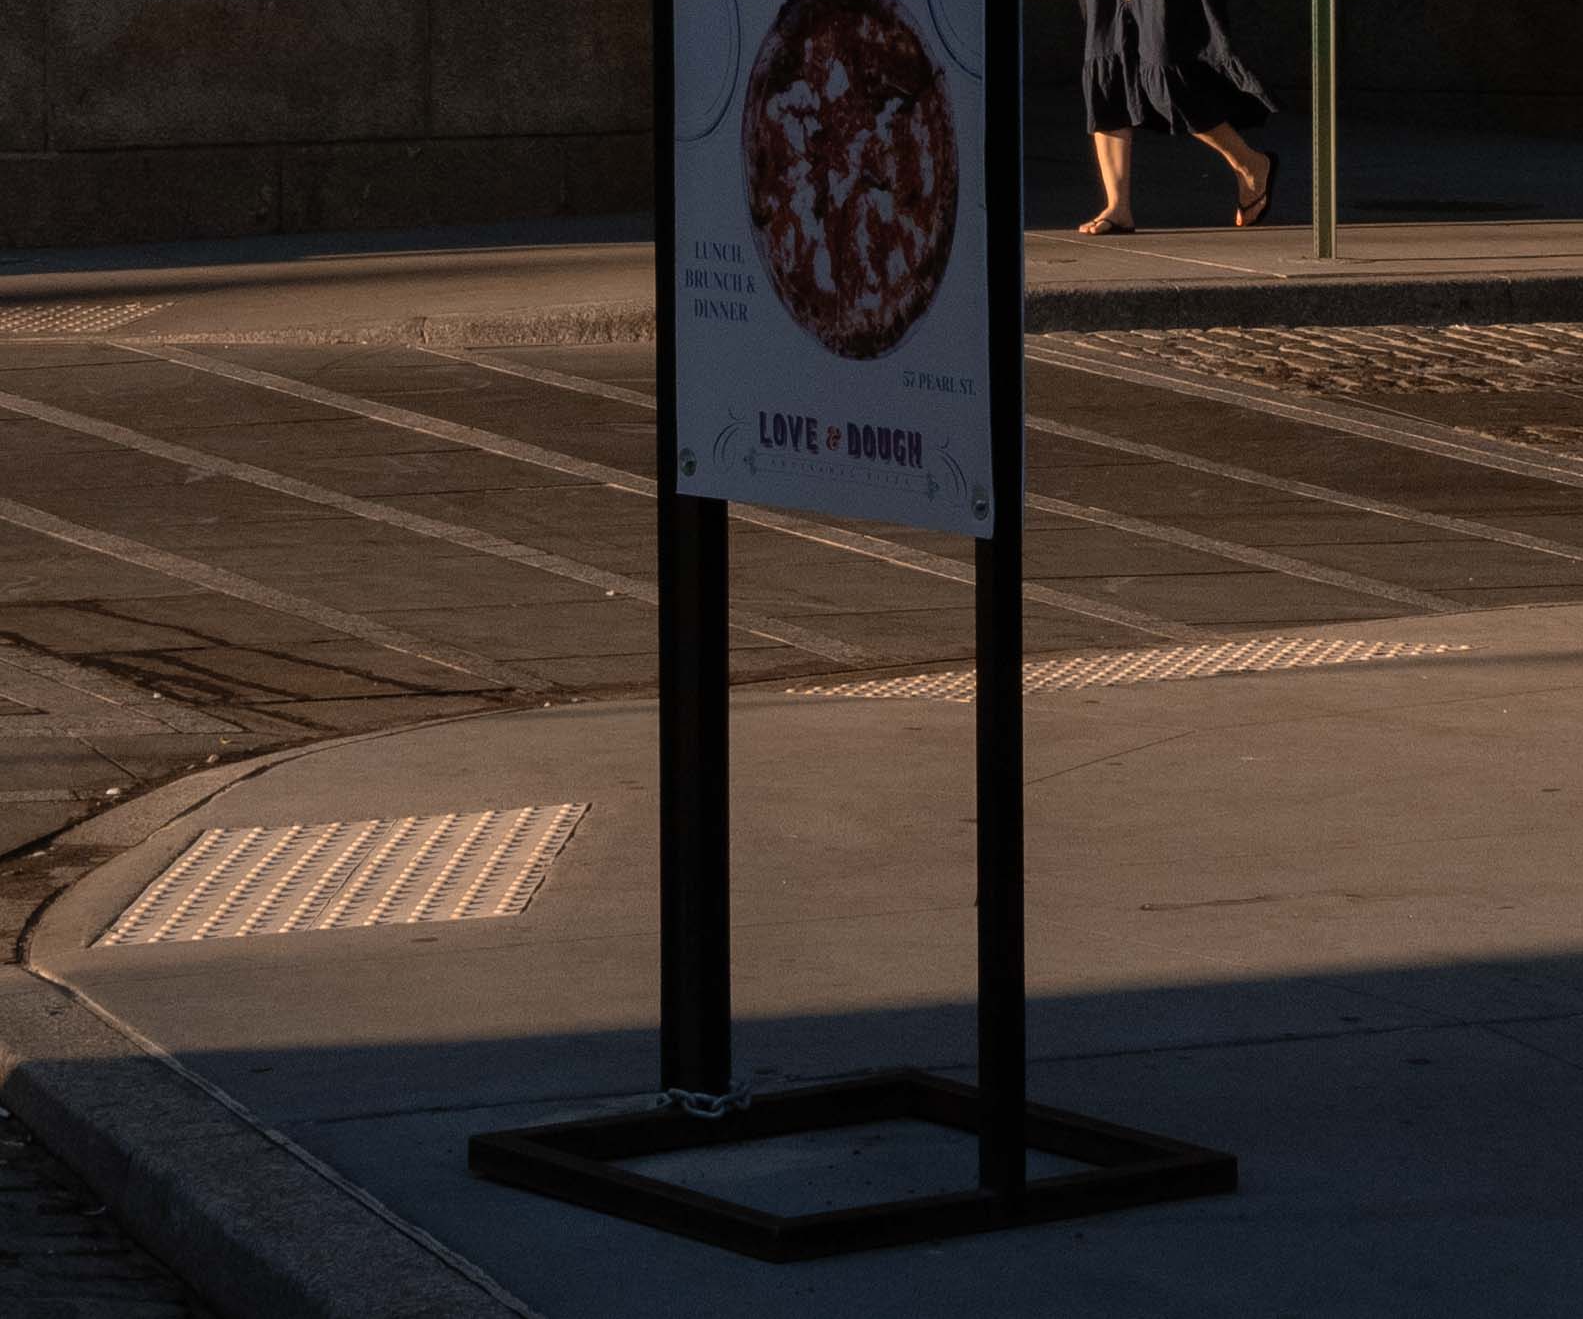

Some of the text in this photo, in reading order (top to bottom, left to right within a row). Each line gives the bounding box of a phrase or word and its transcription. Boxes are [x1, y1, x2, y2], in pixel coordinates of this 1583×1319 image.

[686, 268, 756, 293] BRUNCH &
[694, 297, 749, 322] DINNER
[919, 372, 957, 393] PEARL
[759, 411, 923, 469] LOVE & DOUGH
